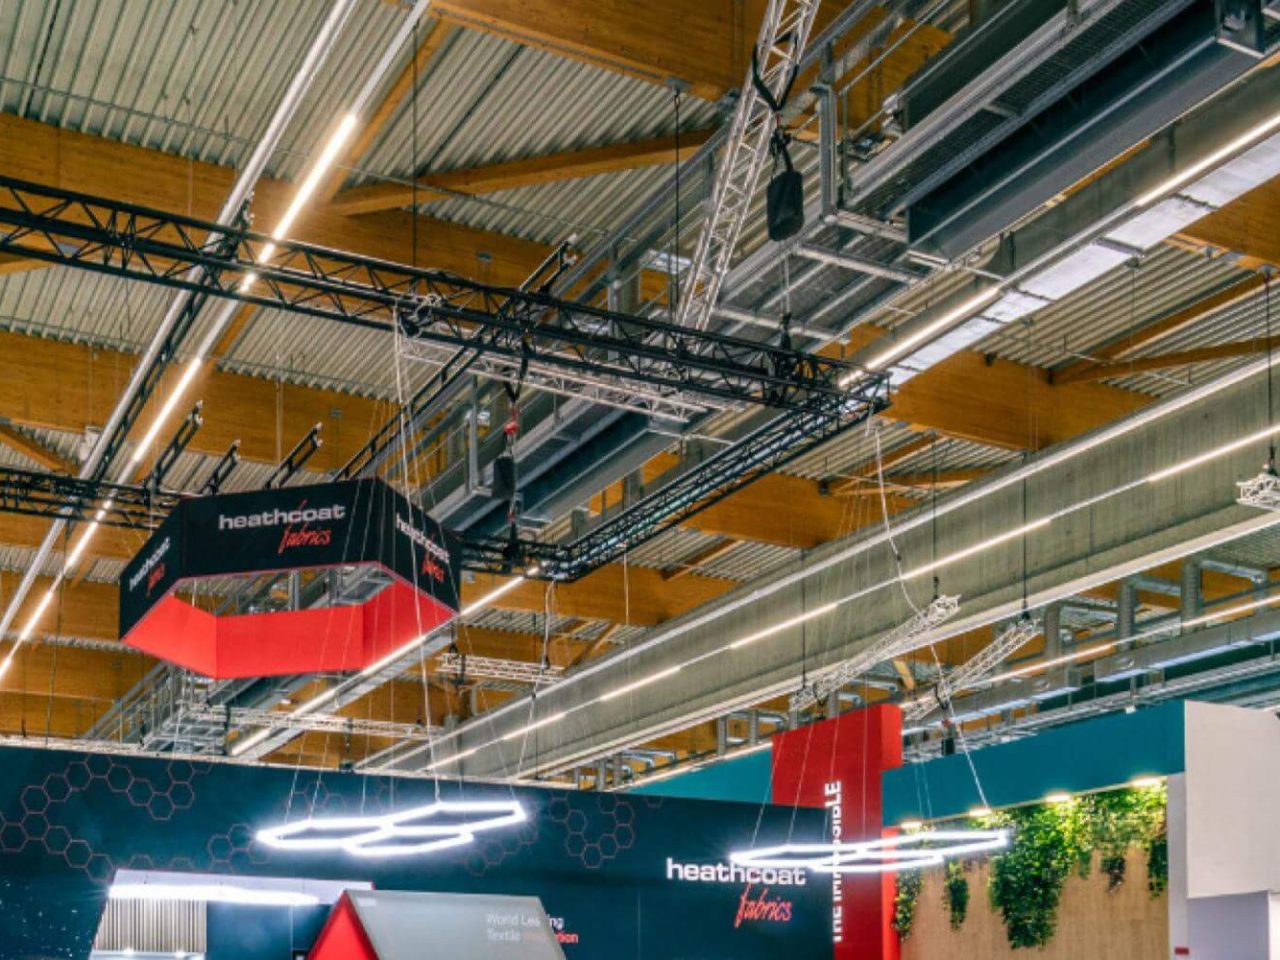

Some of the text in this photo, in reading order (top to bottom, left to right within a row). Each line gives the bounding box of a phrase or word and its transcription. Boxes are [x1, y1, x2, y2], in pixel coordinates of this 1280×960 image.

[219, 503, 347, 531] heathcoat
[278, 505, 332, 554] fabrics
[666, 857, 807, 886] heathcoat
[734, 883, 793, 929] fabrics
